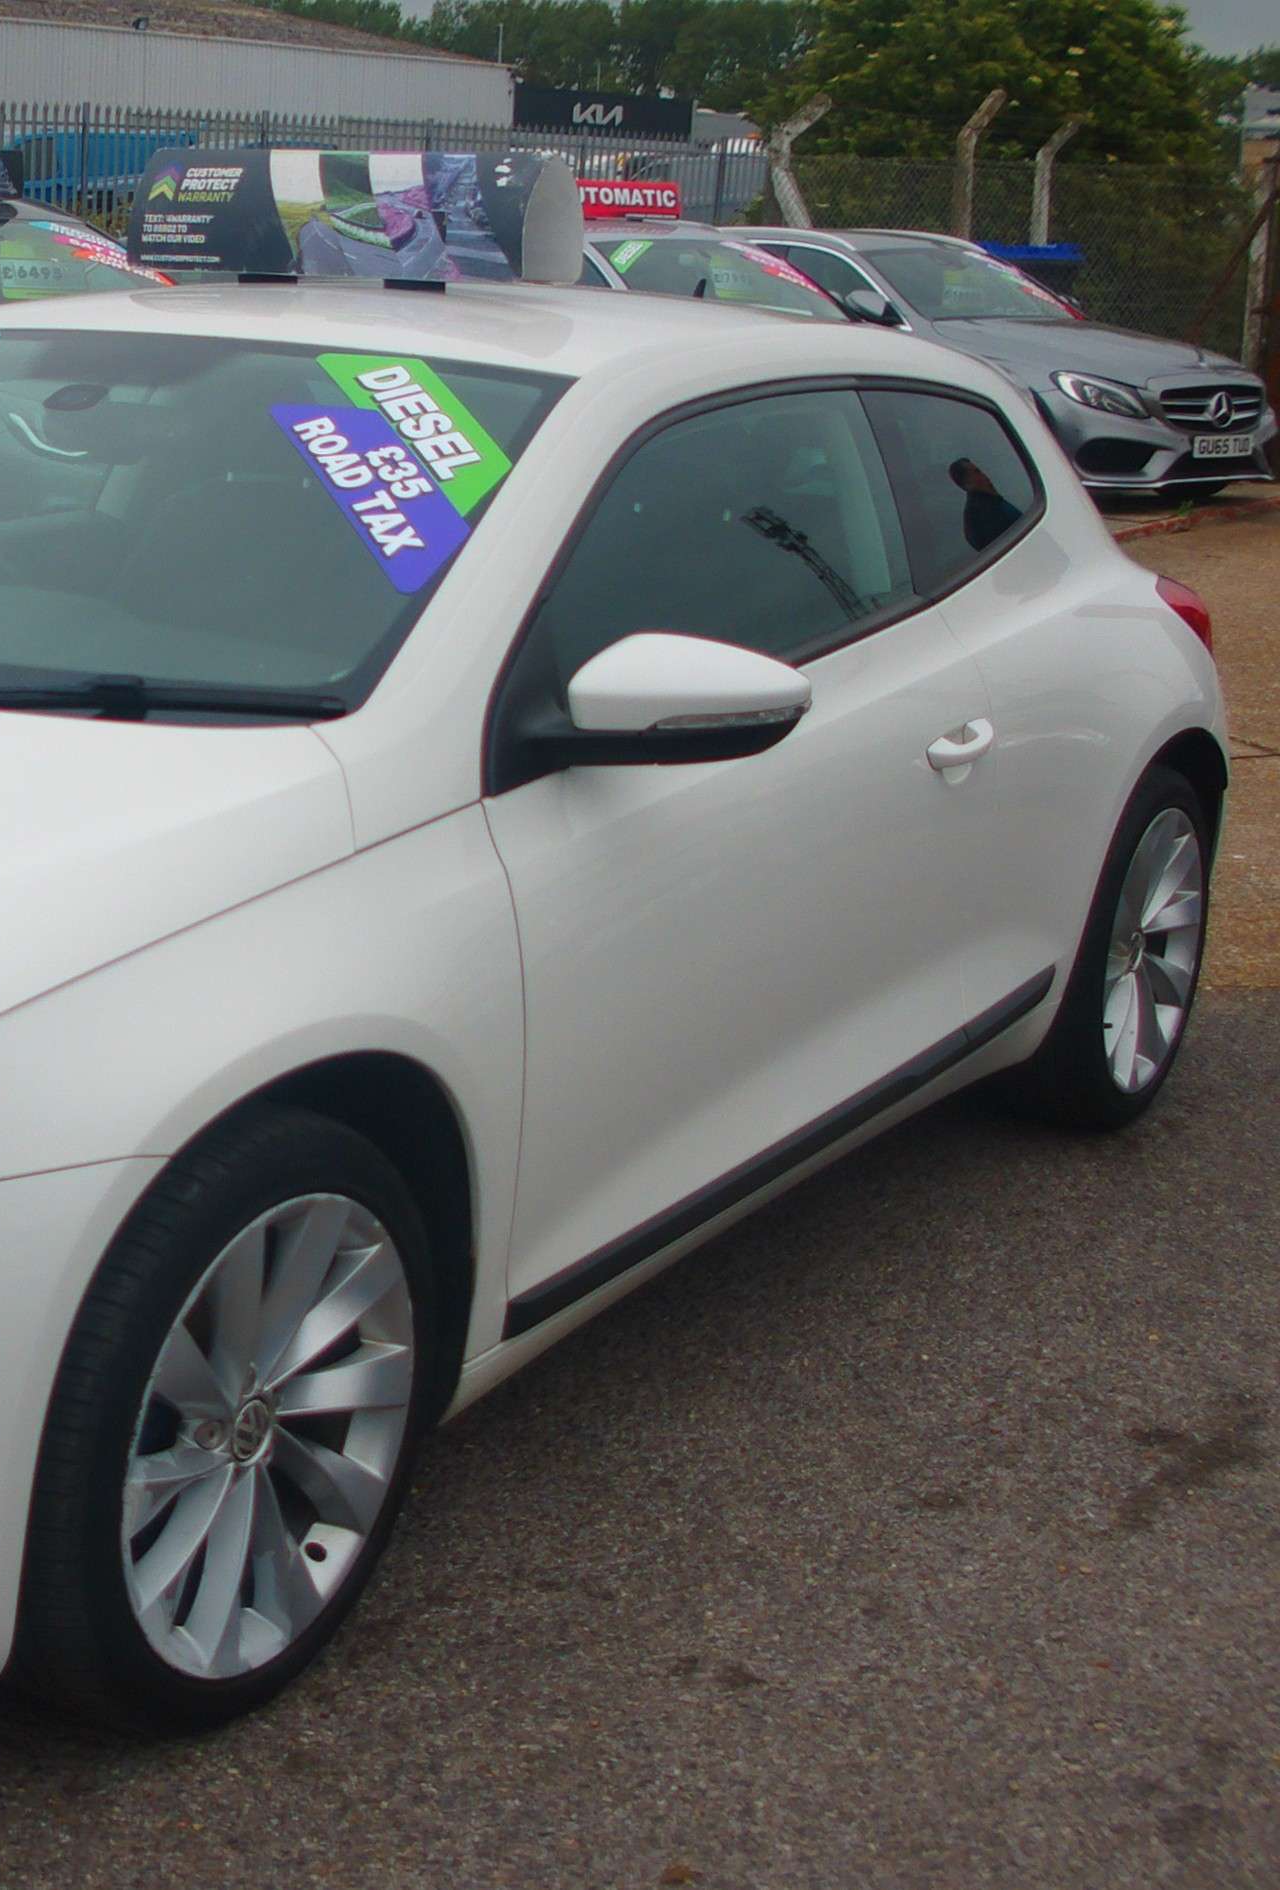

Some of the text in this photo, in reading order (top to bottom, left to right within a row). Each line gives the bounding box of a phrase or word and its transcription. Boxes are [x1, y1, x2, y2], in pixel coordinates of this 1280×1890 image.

[180, 178, 238, 191] PROTECT
[186, 167, 243, 178] CUSTOMER
[177, 191, 235, 203] WARRANTY
[357, 366, 482, 481] DIESEL
[292, 416, 425, 557] ROAD TAX
[365, 446, 433, 499] £35
